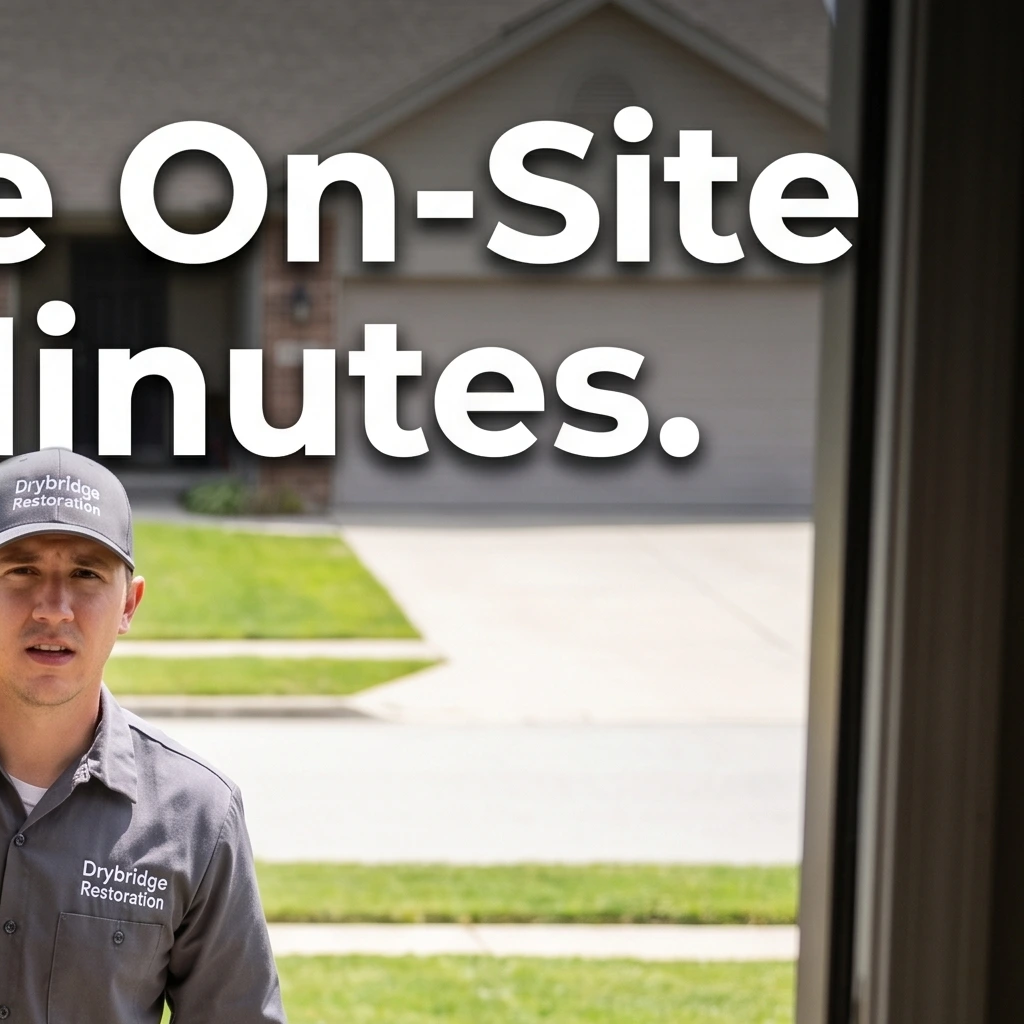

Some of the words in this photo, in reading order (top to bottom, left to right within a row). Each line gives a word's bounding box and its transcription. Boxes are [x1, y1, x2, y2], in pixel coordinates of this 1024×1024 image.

[15, 474, 100, 501] Drybridge
[12, 494, 100, 516] Restoration
[82, 859, 168, 893] Drybridge
[80, 880, 165, 910] Restoration
